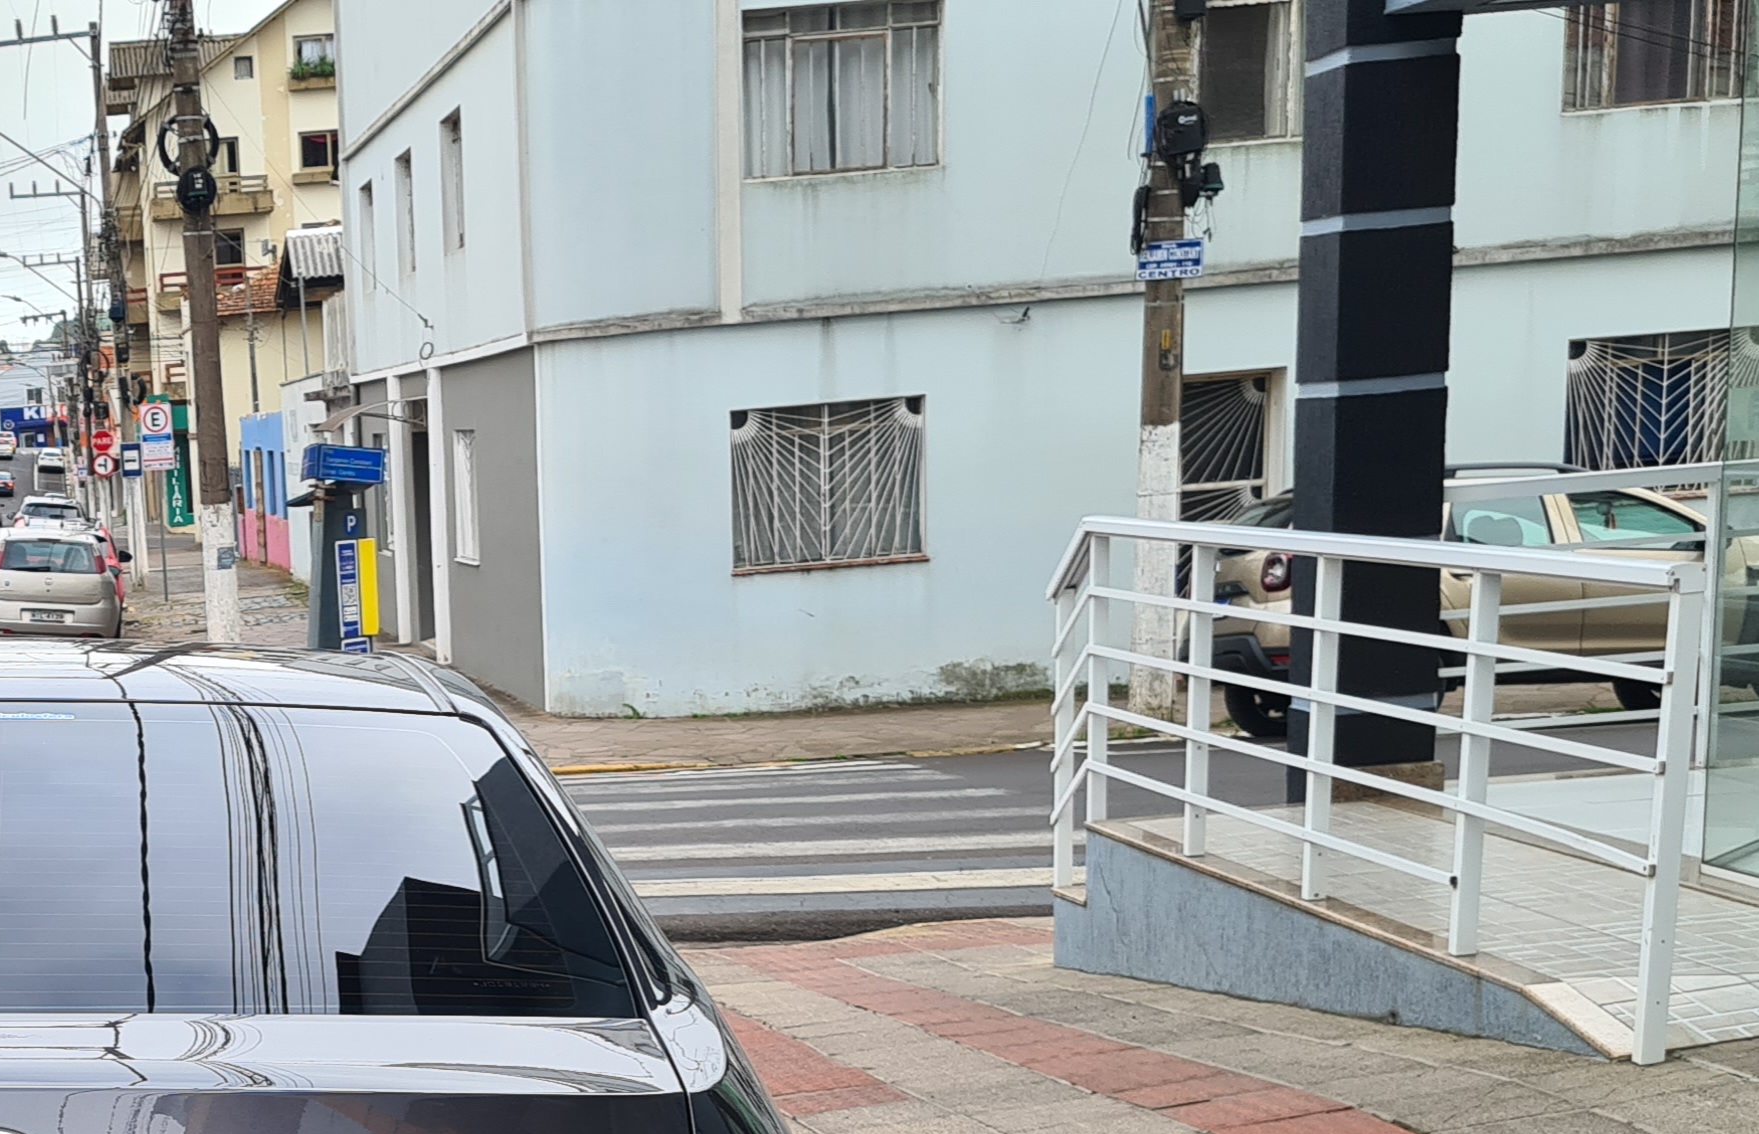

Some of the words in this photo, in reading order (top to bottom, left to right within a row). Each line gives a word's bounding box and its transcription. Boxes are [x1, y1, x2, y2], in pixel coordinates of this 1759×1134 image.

[1138, 268, 1200, 279] CENTRO
[151, 412, 160, 427] E
[346, 515, 357, 532] P
